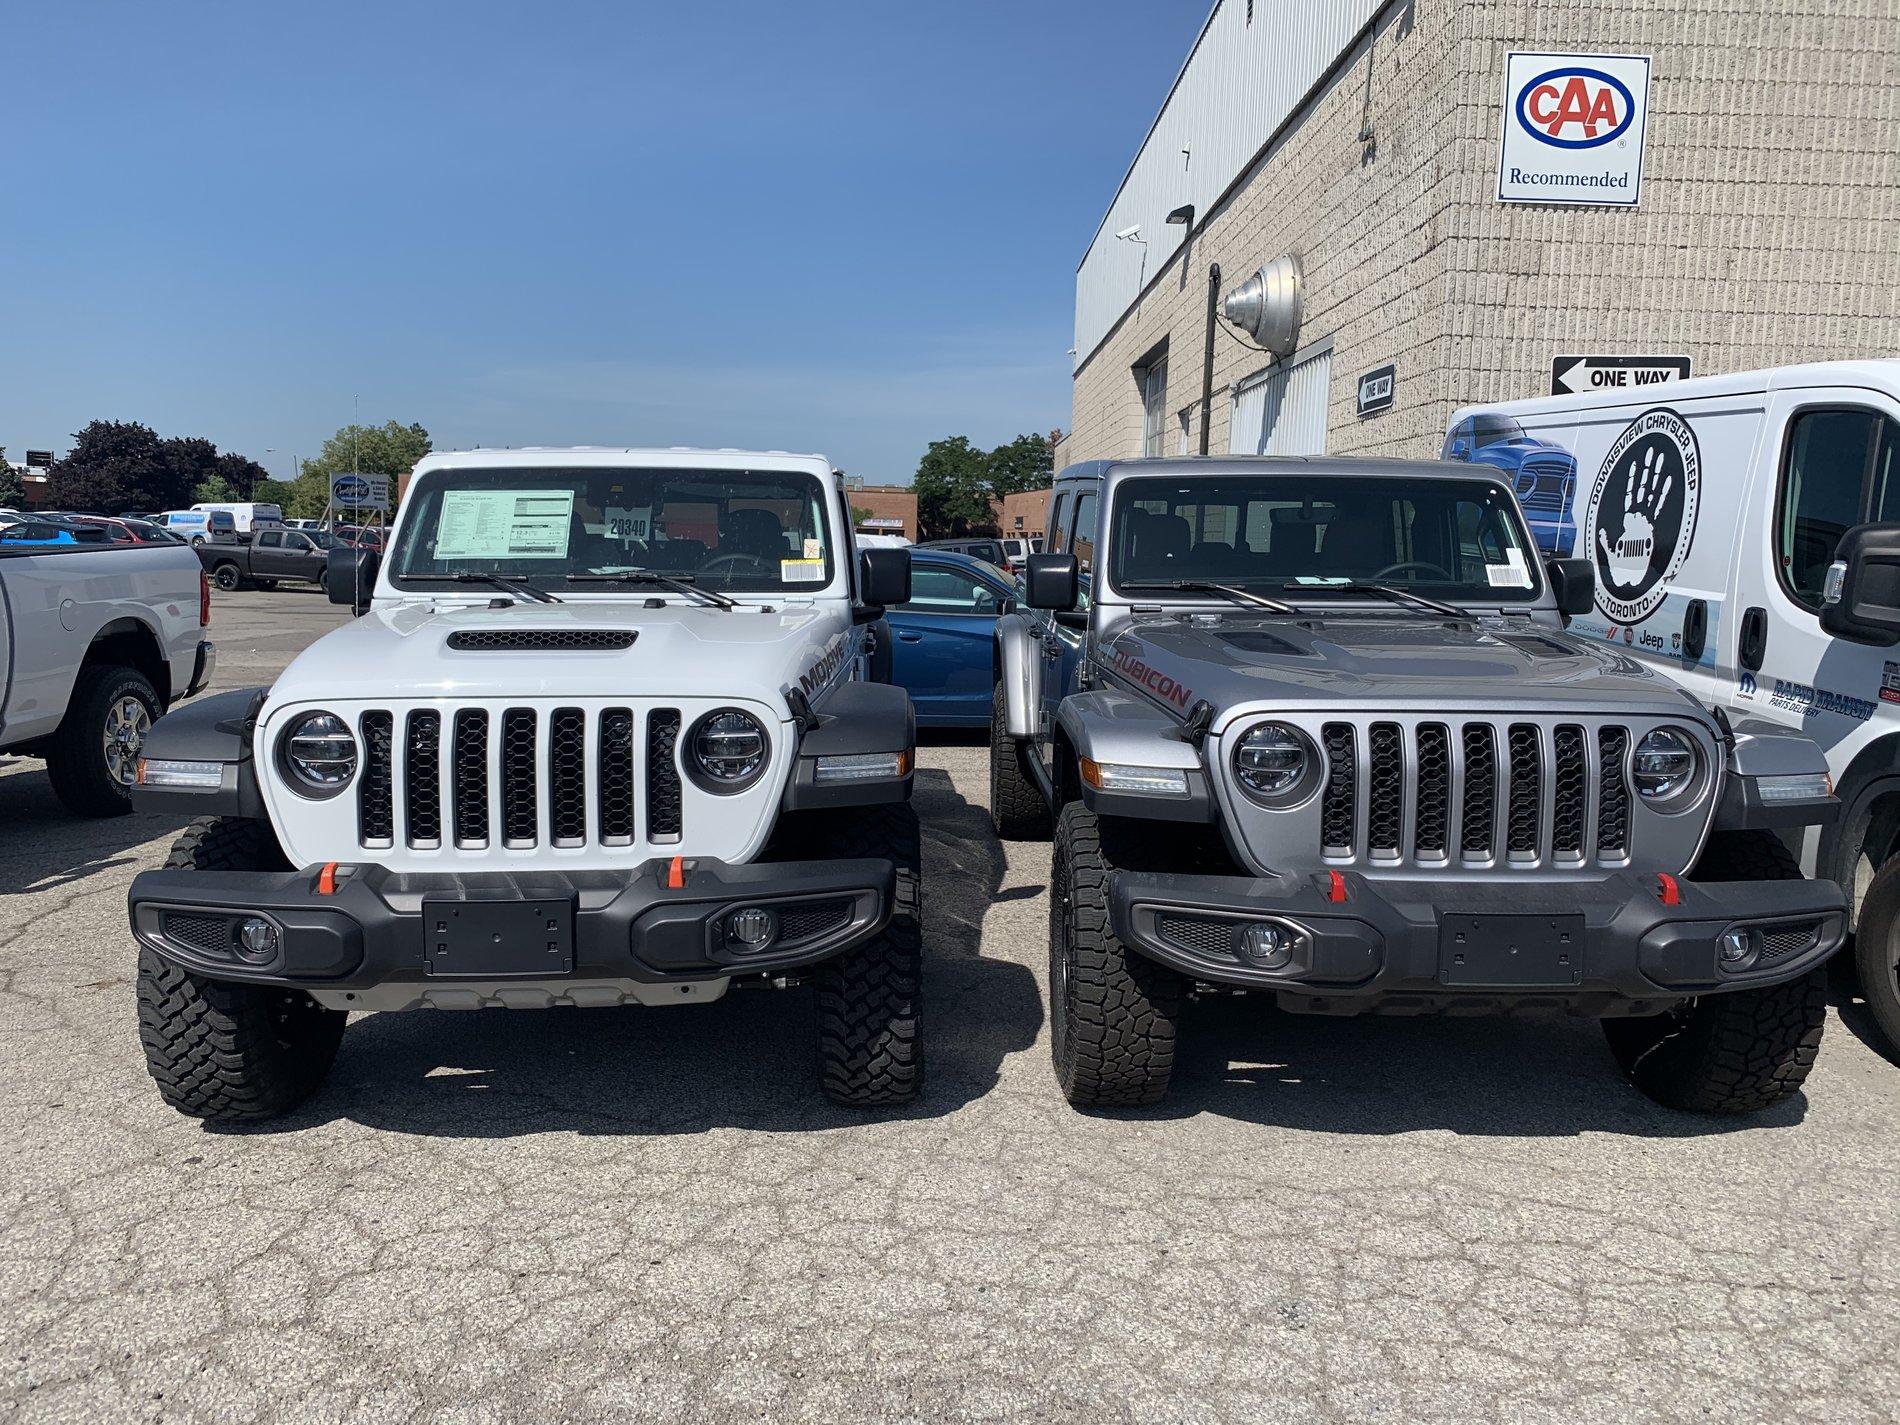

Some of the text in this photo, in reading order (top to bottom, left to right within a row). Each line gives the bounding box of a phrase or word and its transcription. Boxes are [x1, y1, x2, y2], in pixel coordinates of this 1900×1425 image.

[1529, 77, 1618, 138] CAA
[1509, 168, 1628, 188] Recommended
[1366, 377, 1390, 399] ONE WAY
[1591, 370, 1671, 387] ONE WAY
[1592, 415, 1696, 506] DOWNSVIEW CHRYSLER JEEP
[611, 518, 646, 537] 20340
[1605, 596, 1649, 618] TORONTO
[1640, 630, 1663, 651] Jeep
[1113, 649, 1192, 708] RUBICON
[1768, 697, 1822, 718] PARTS DELIVERY
[1772, 679, 1815, 705] RAPID
[1815, 689, 1879, 721] TRANSIT
